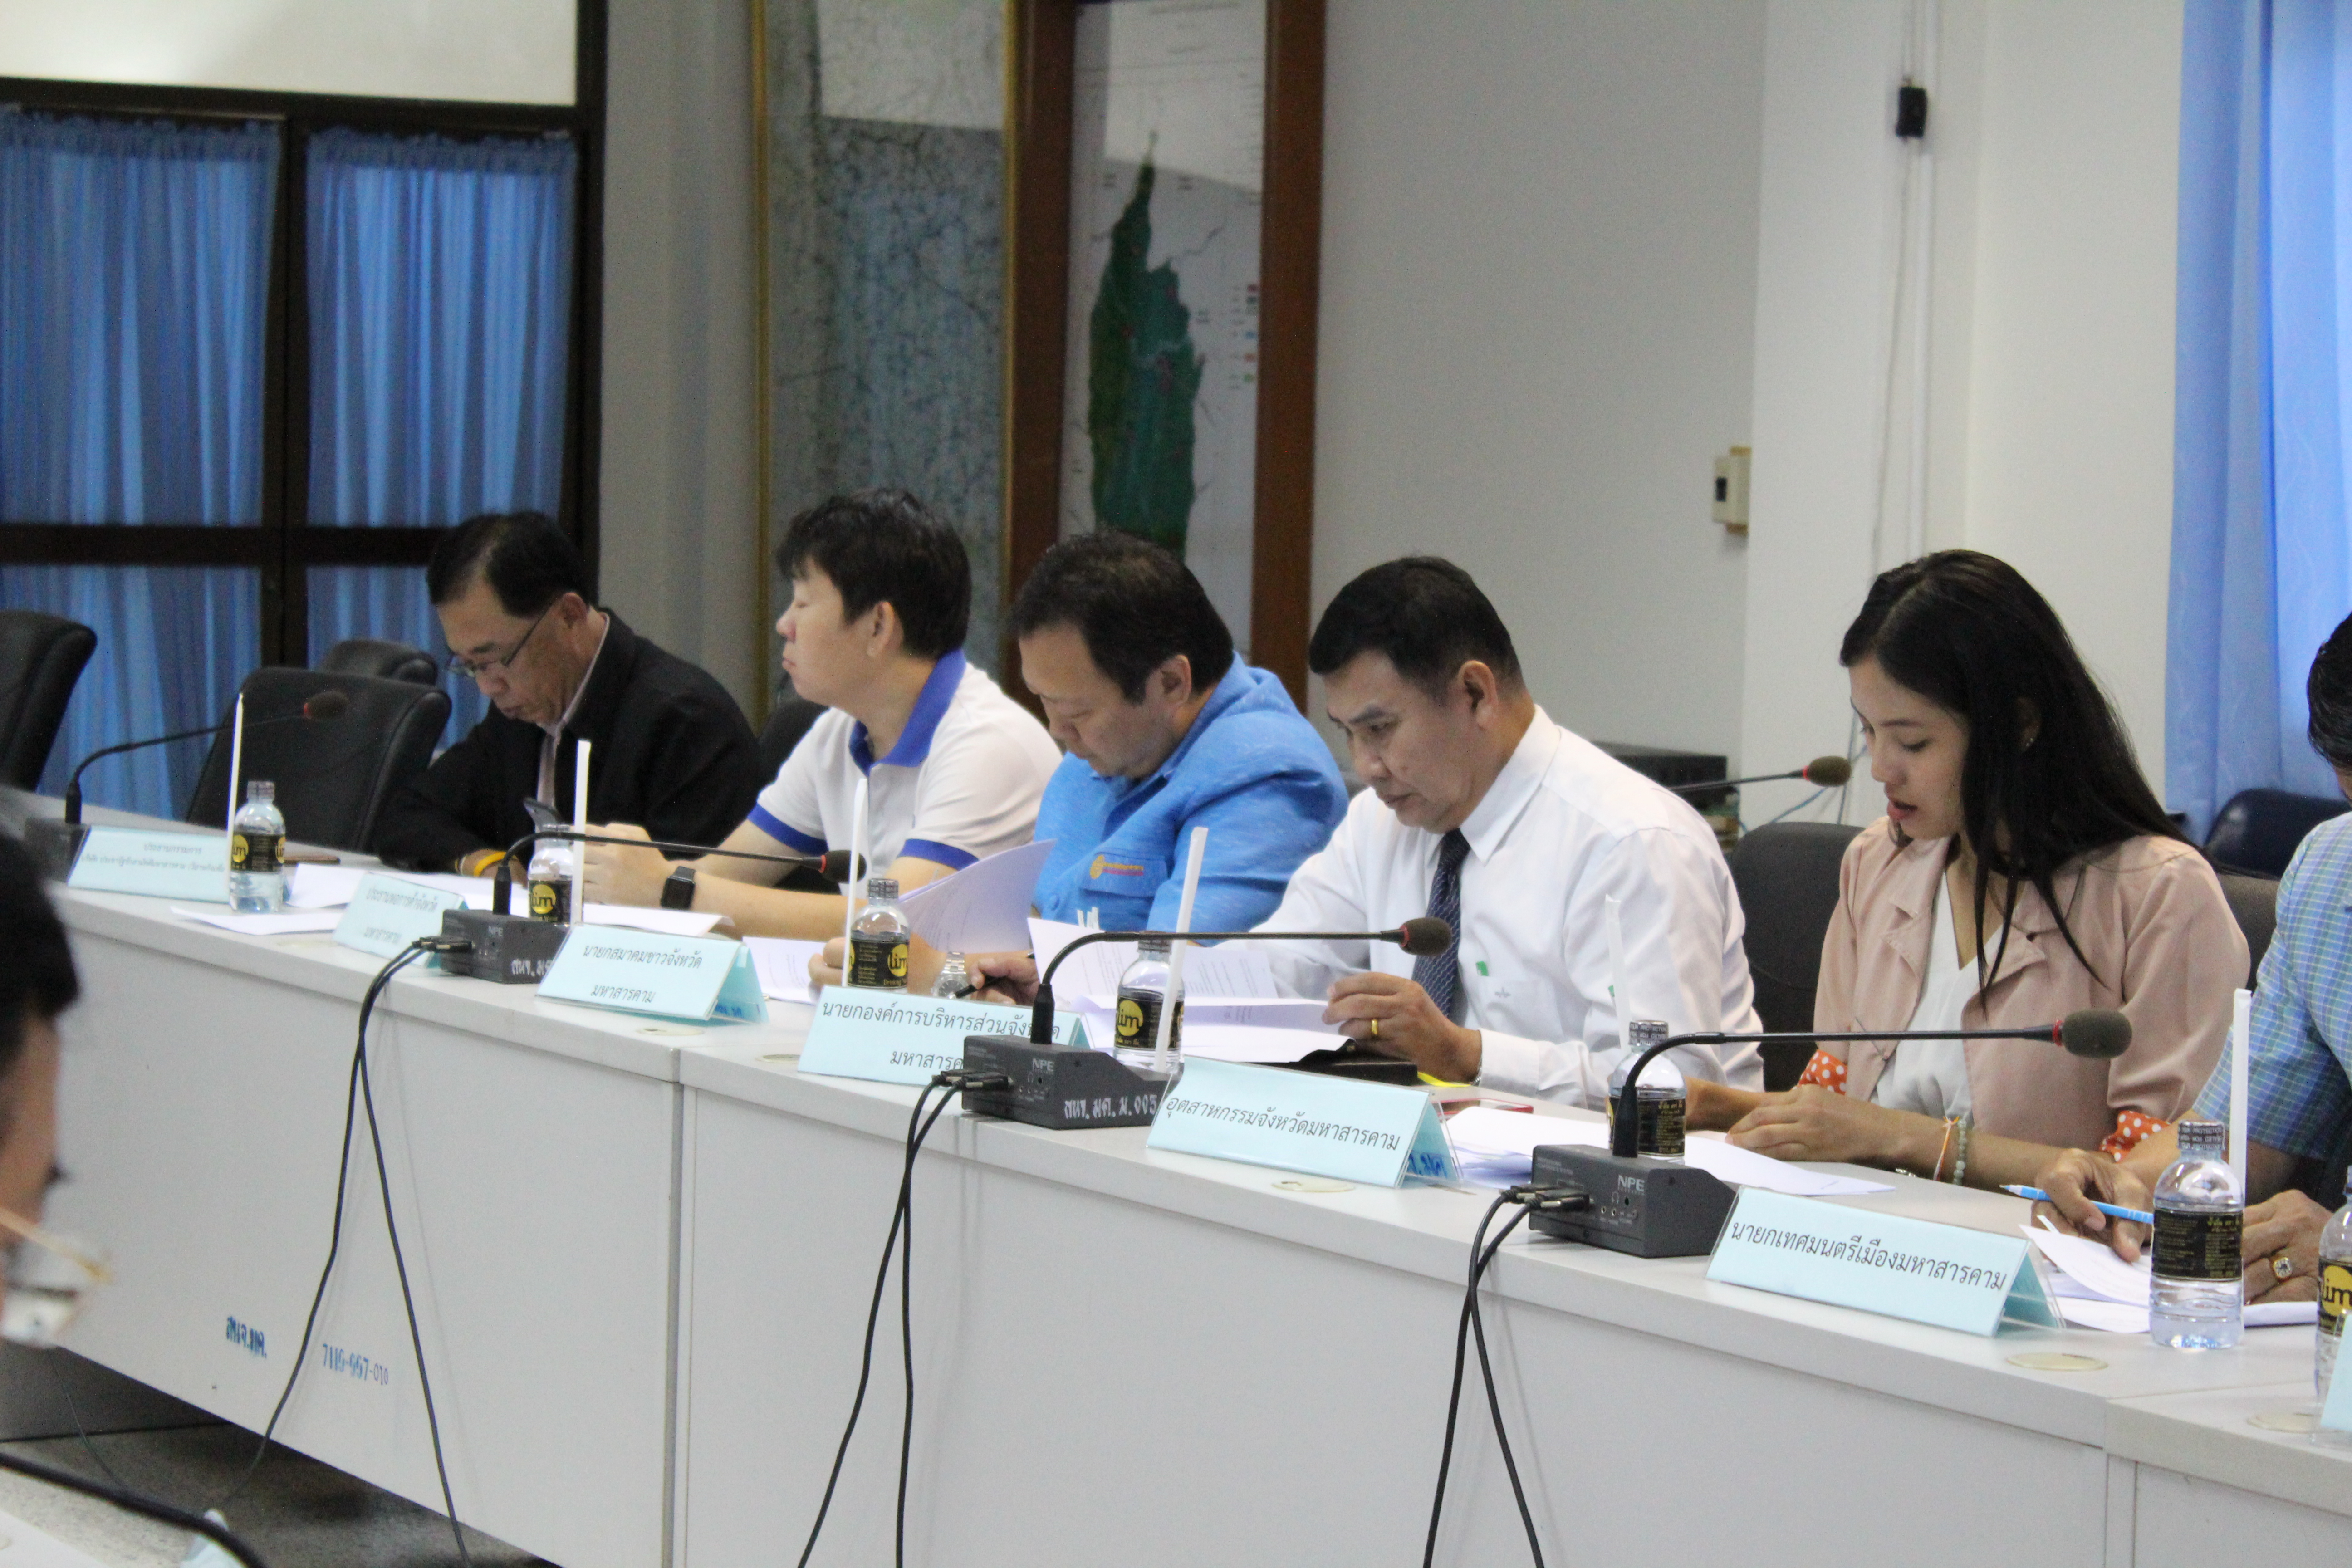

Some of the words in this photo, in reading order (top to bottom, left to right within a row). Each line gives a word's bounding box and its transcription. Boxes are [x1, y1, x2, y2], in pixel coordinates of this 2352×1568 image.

[583, 945, 703, 970] นายกสมาคมชาวจังหวัด
[590, 984, 656, 1003] มหาสารคาม
[890, 1050, 963, 1071] มหาสารค
[1033, 1058, 1055, 1072] NPE
[1166, 1096, 1401, 1151] อุตสาหกรรมจังหวัดมหาสารคาม
[1618, 1174, 1645, 1191] NPE
[1730, 1221, 2008, 1291] นายกเทศมนตรีเมืองมหาสารคาม
